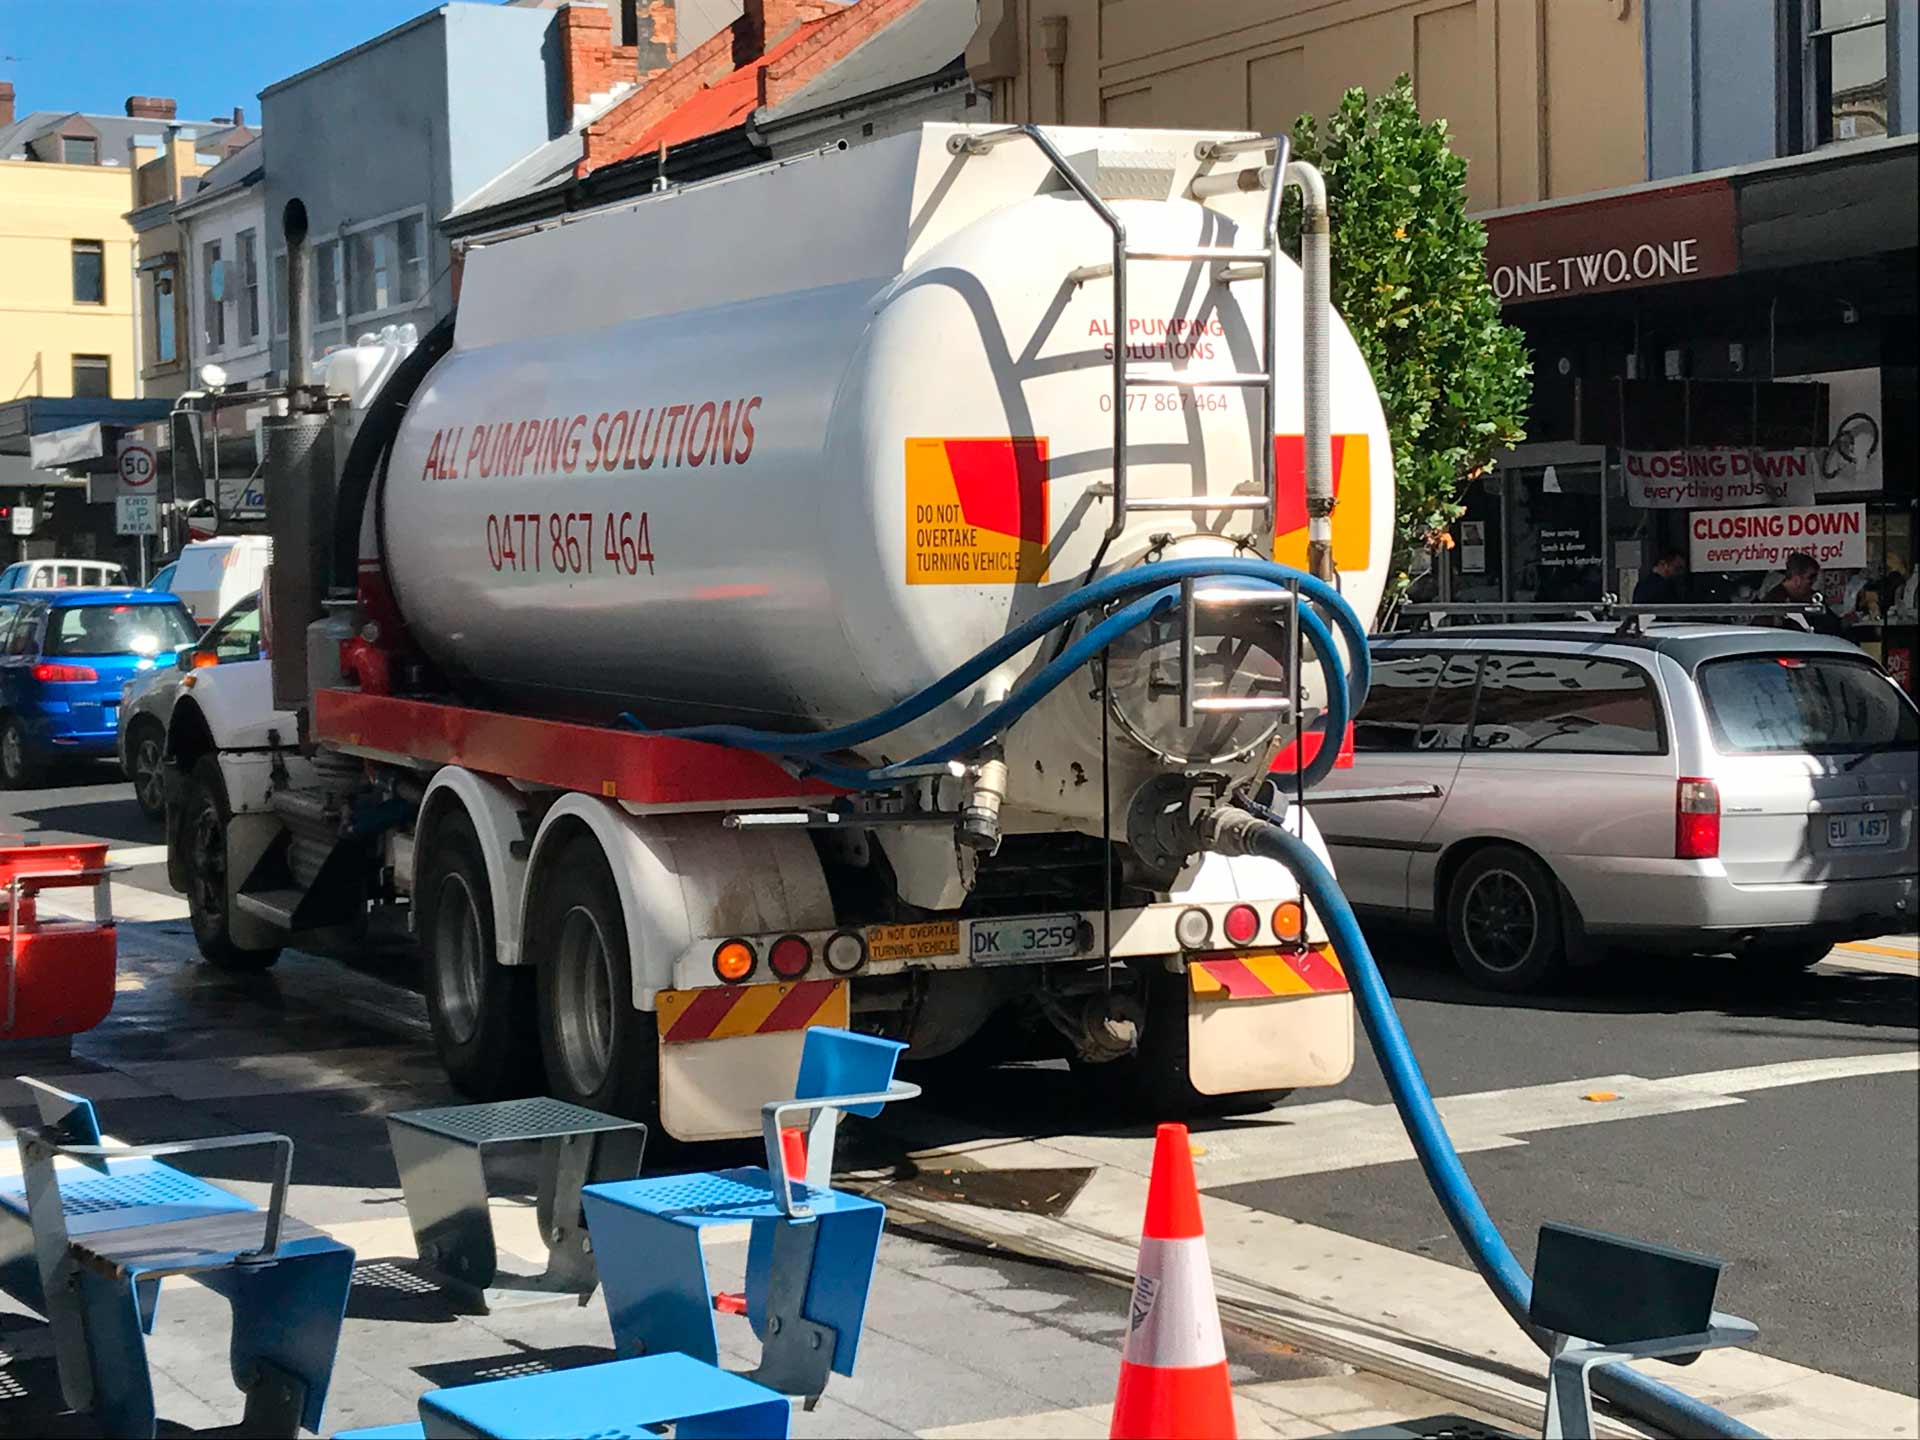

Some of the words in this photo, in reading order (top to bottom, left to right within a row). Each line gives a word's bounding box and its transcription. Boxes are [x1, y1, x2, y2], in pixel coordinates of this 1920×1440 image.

[1493, 239, 1698, 298] ONE.TWO.ONE
[1088, 319, 1116, 336] AL
[1129, 318, 1224, 336] PUMPING
[1099, 393, 1147, 412] 077
[1155, 393, 1189, 411] 867
[1195, 394, 1228, 411] 464
[422, 426, 464, 481] ALL
[464, 414, 588, 479] PUMPING
[585, 396, 763, 472] SOLUTIONS
[124, 457, 149, 475] 50
[1627, 454, 1726, 478] CLOSING
[1644, 480, 1723, 503] everything
[1728, 482, 1766, 497] mus
[917, 504, 933, 524] DO
[937, 504, 960, 523] NOT
[1693, 514, 1783, 540] CLOSING
[1788, 512, 1859, 536] DOWN
[487, 513, 541, 572] 0477
[549, 512, 593, 574] 867
[604, 512, 655, 576] 464
[917, 528, 977, 547] OVERTAKE
[917, 552, 969, 571] TURNING
[1707, 544, 1778, 565] everything
[1821, 540, 1843, 562] go!
[1831, 822, 1847, 838] EU
[1858, 819, 1888, 837] 1497
[887, 927, 905, 940] NOT
[910, 925, 959, 939] OVERTAKE
[974, 931, 1000, 953] DK
[1022, 926, 1077, 950] 3259
[872, 943, 914, 958] TURNING
